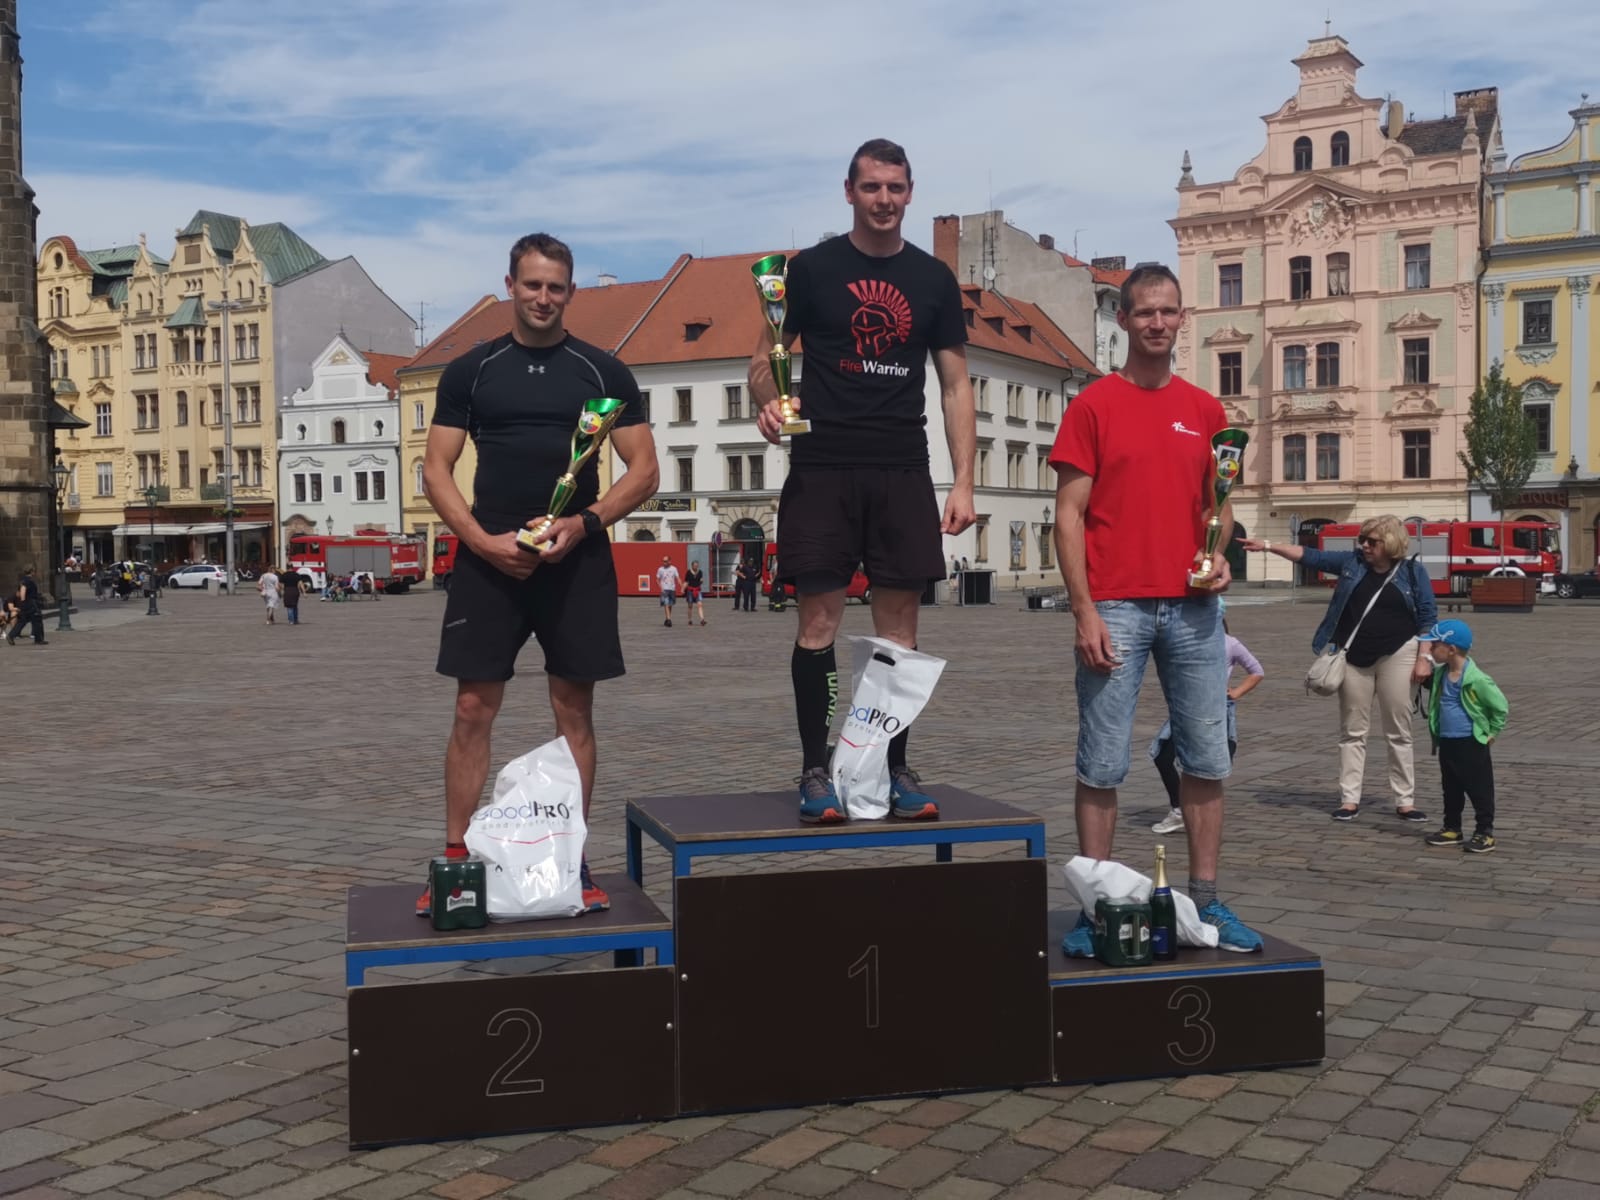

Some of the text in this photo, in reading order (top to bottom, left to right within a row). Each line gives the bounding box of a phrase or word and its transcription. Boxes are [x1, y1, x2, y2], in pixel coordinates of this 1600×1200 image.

[848, 944, 880, 1029] 1
[1167, 984, 1216, 1066] 3
[485, 1007, 544, 1097] 2
